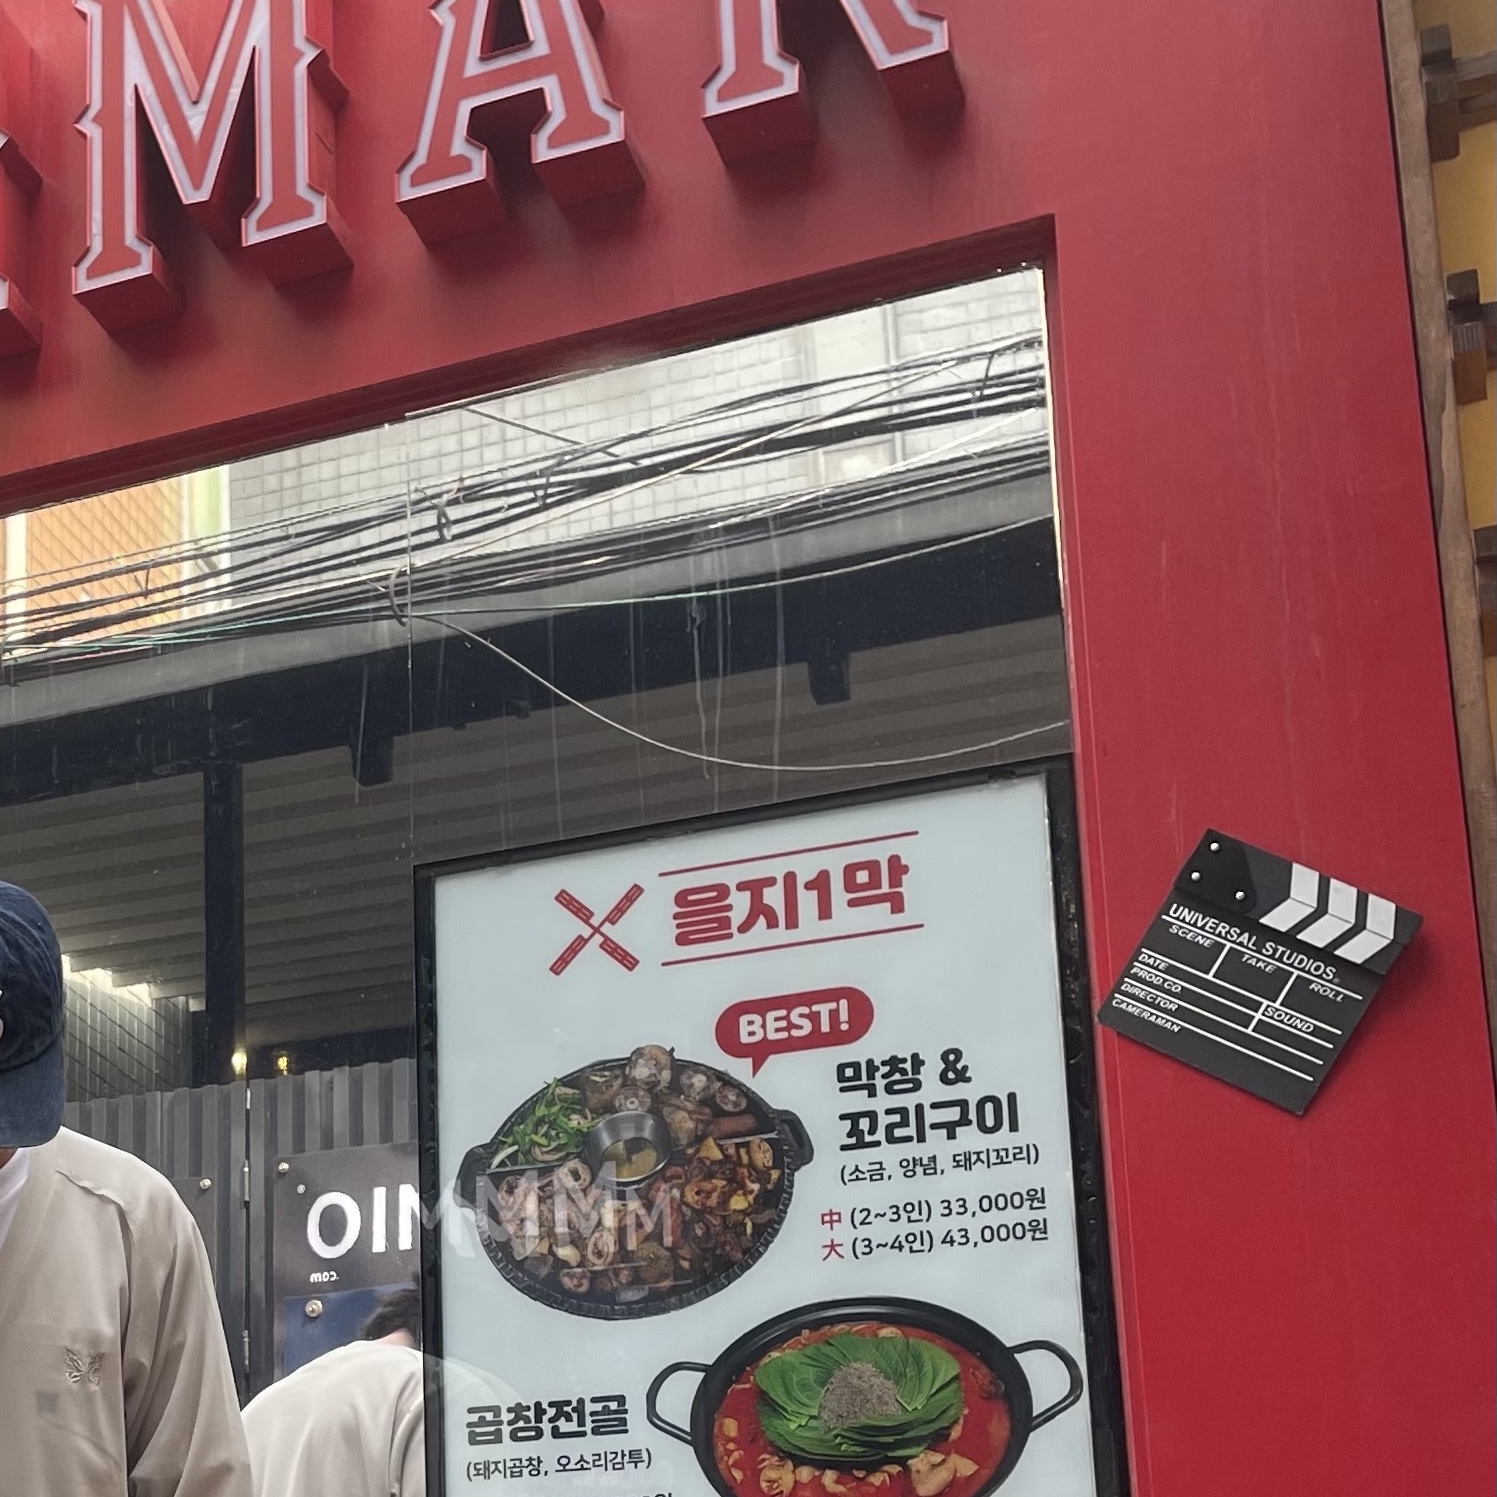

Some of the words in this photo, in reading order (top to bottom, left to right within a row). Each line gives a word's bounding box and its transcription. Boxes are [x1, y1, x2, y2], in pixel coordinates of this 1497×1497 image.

[673, 855, 909, 946] 을지1막
[1169, 903, 1257, 949] UNIVERSAL
[1169, 924, 1215, 948] SCENE
[1138, 953, 1169, 971] DATE
[1240, 954, 1278, 974] TAKE
[1120, 982, 1179, 1012] DIRECTOR
[1309, 982, 1344, 1002] ROLL
[739, 998, 851, 1045] BEST!
[1111, 998, 1182, 1033] CAMERAMAN
[1264, 1006, 1315, 1033] SOUND
[837, 1053, 925, 1098] 막창
[939, 1048, 972, 1085] &
[839, 1092, 1019, 1152] 꼬리구이
[951, 1144, 1040, 1175] 돼지꼬리)
[821, 1209, 841, 1230] 中
[940, 1187, 1046, 1221] 33,000원
[822, 1239, 844, 1261] 大
[941, 1218, 1048, 1251] 43,000원
[466, 1395, 629, 1445] 곱창전골
[554, 1447, 652, 1476] 오소리감투)
